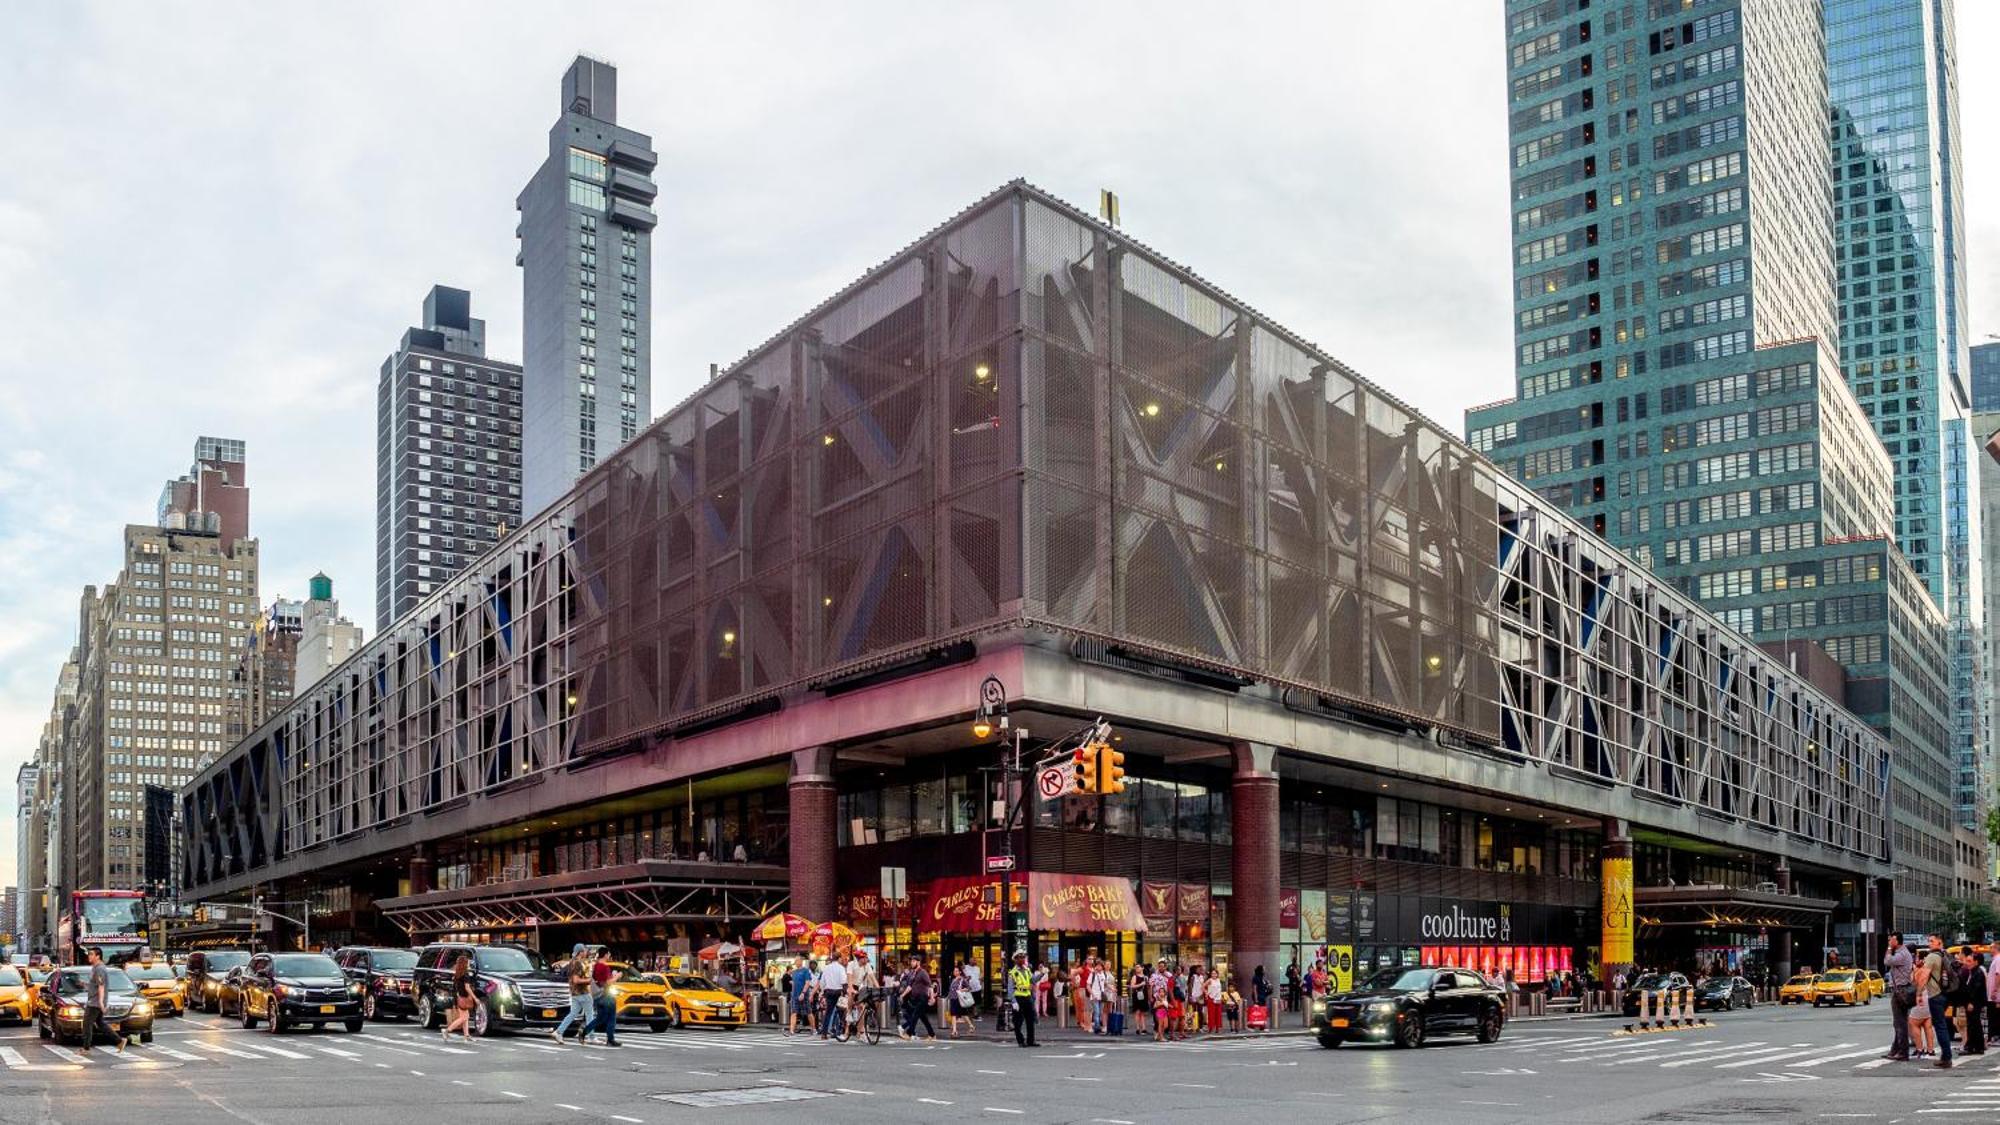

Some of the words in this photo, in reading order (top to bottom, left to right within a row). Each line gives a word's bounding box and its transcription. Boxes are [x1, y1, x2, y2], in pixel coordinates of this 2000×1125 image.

[1042, 884, 1085, 918] CARLO'S
[1086, 884, 1123, 902] BAKE
[1089, 903, 1129, 921] SHOP
[1422, 904, 1497, 938] coolture
[1606, 911, 1632, 929] CT
